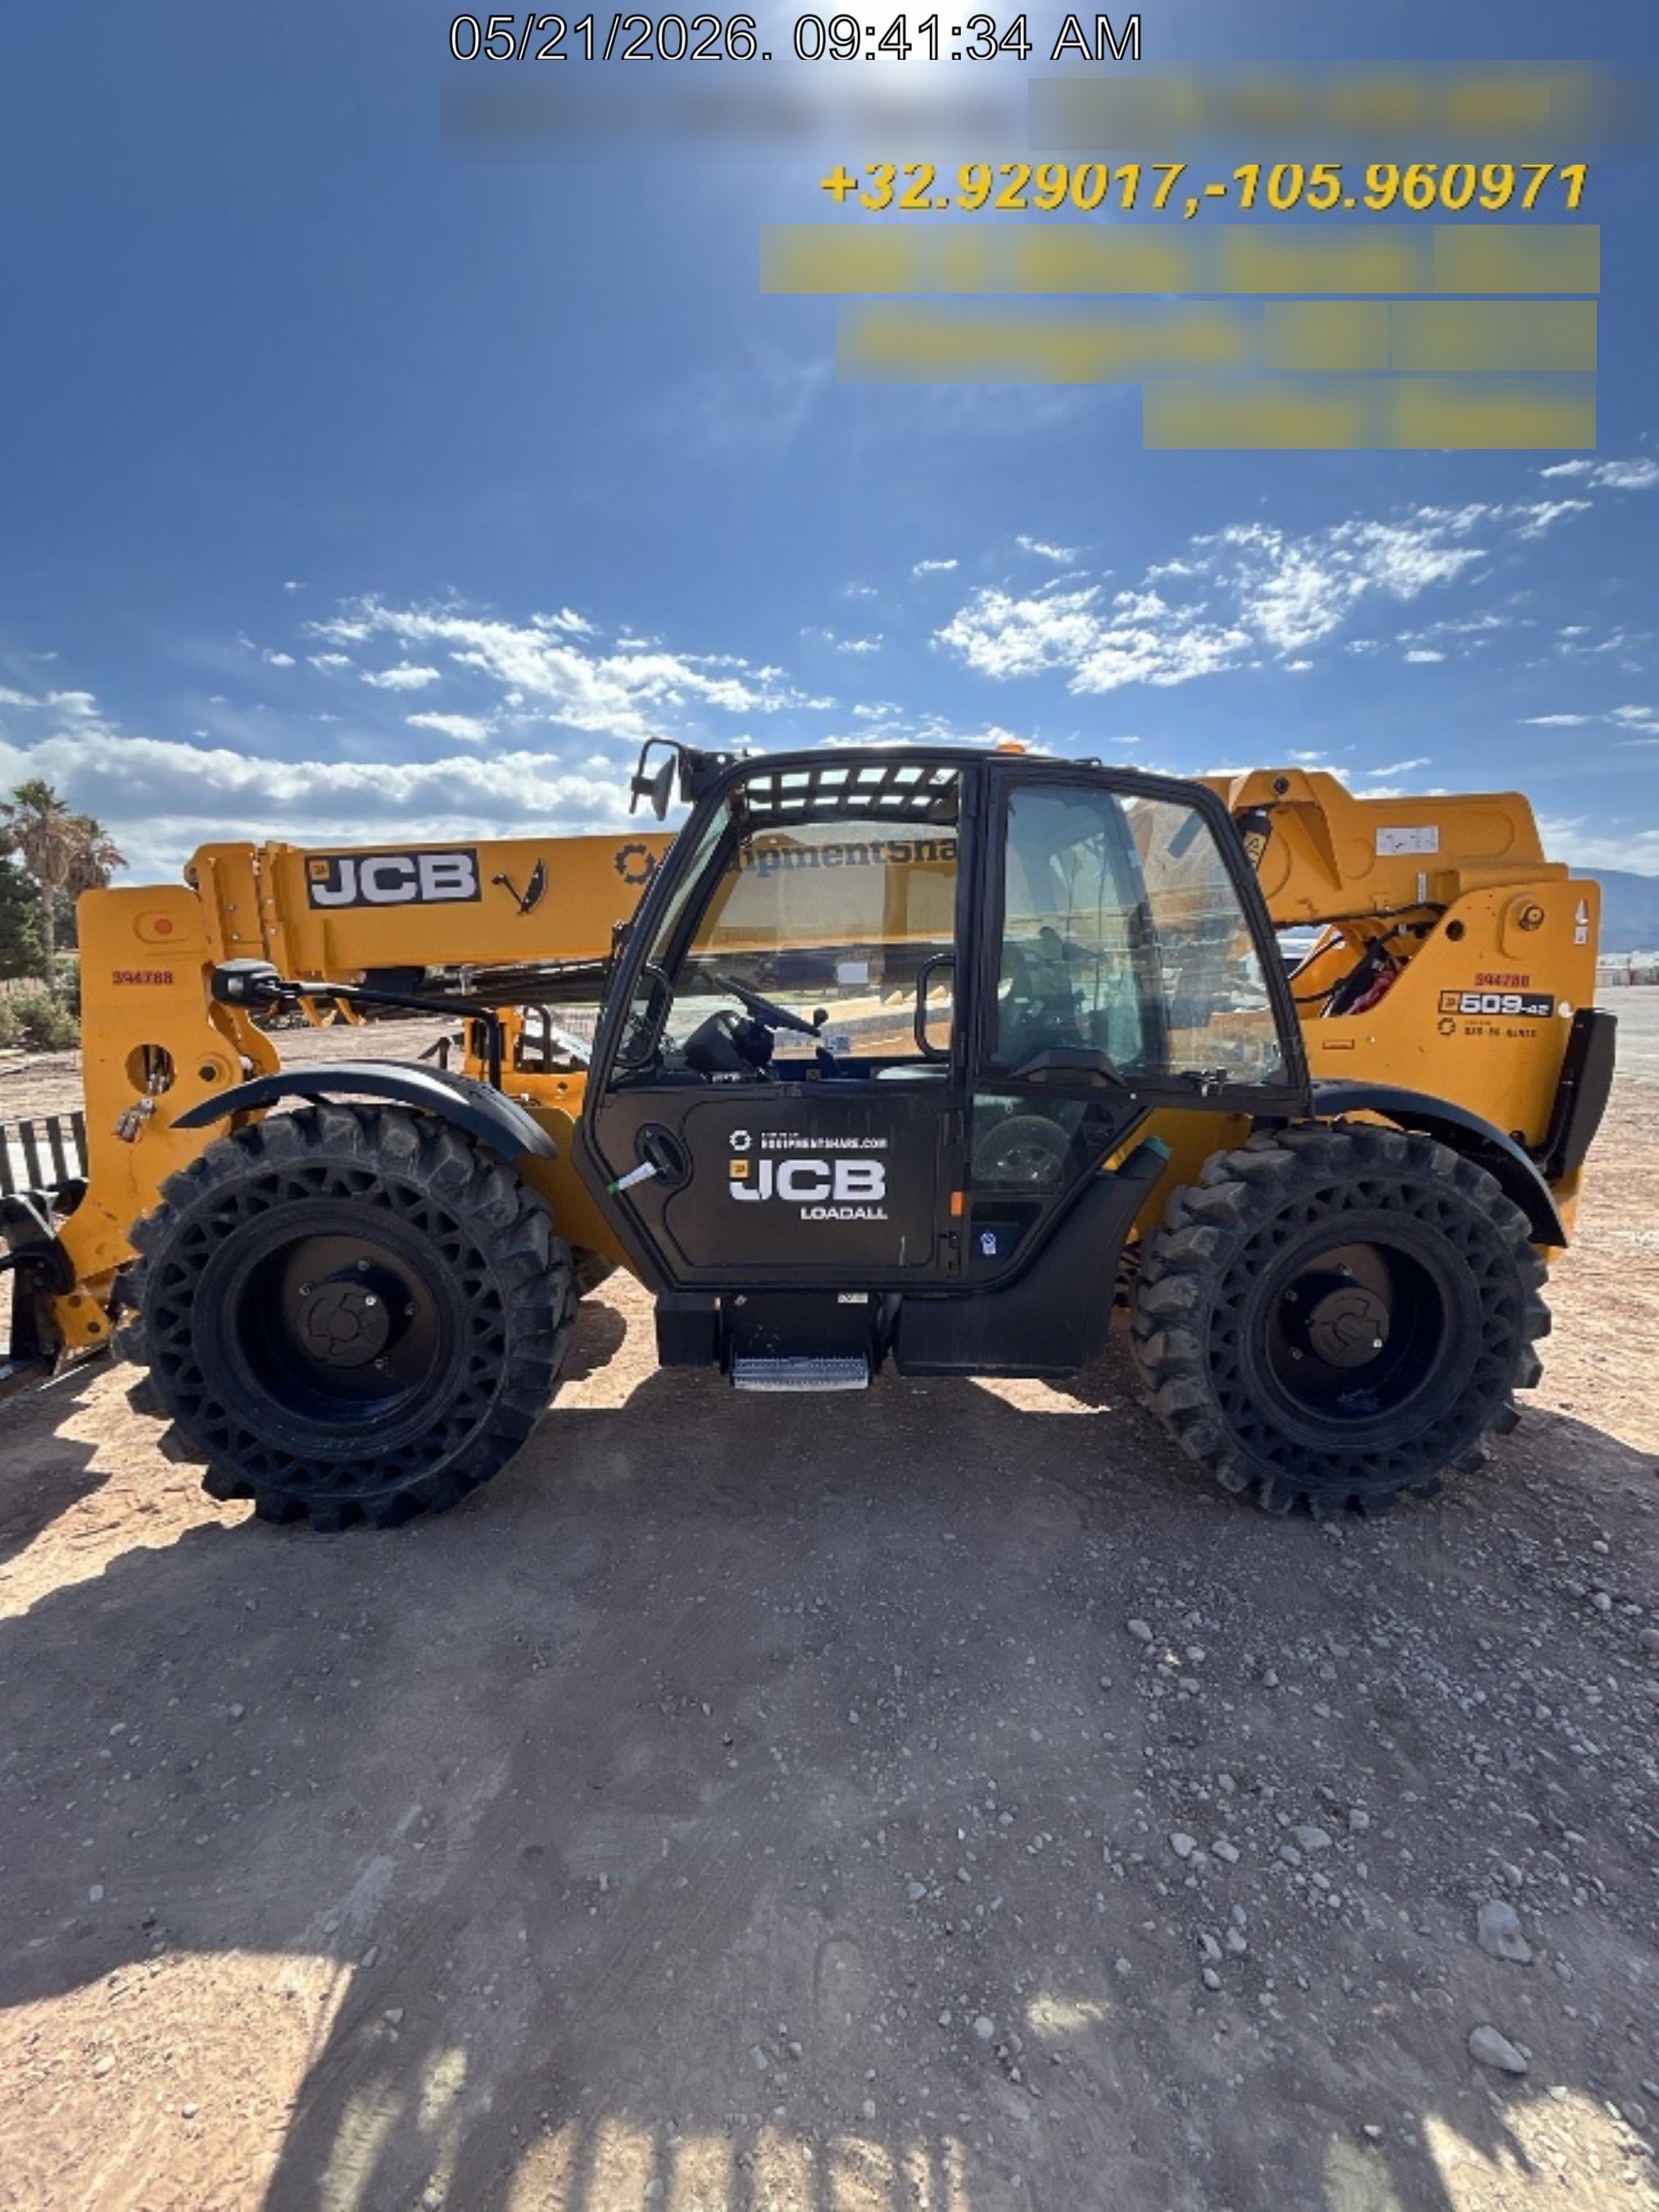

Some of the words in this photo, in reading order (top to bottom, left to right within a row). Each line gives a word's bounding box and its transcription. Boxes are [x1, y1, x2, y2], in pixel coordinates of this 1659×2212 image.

[310, 854, 477, 905] JCB
[728, 1158, 886, 1201] JCB
[800, 1206, 888, 1221] LOADALL
